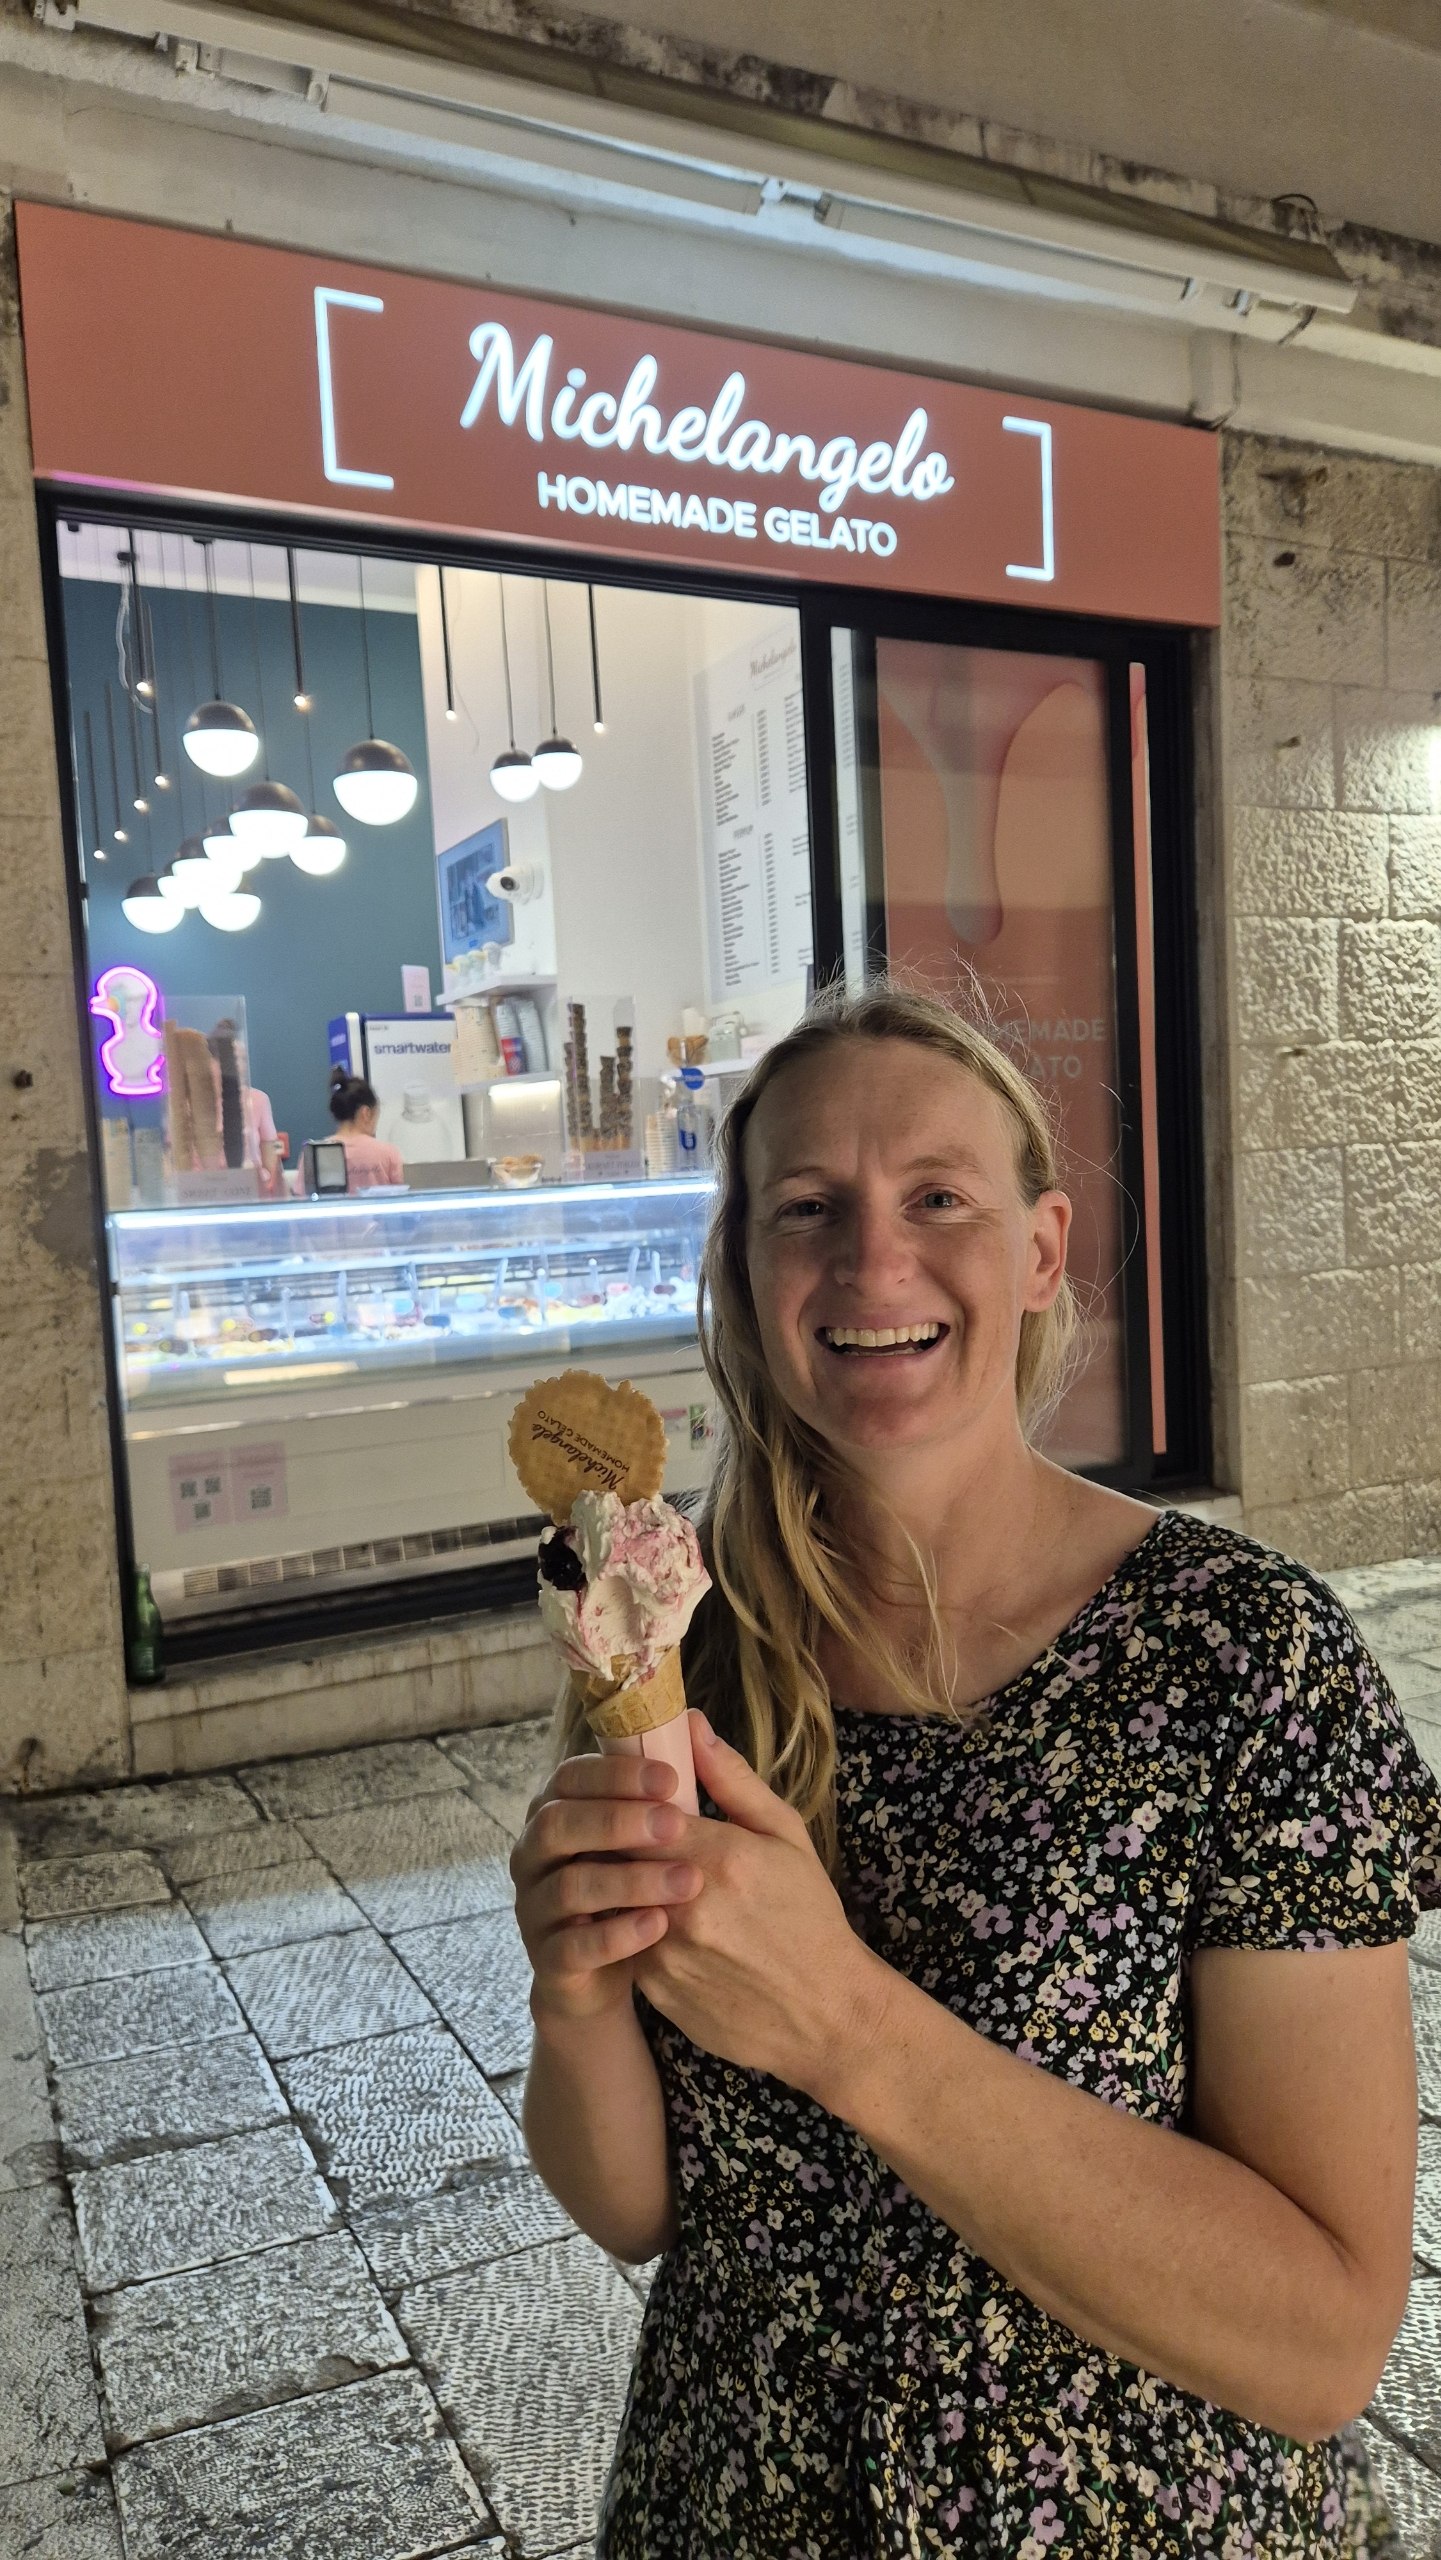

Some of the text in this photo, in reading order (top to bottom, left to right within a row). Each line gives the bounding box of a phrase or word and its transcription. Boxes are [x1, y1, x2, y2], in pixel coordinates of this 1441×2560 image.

[460, 322, 955, 513] Michelangelo
[538, 472, 898, 557] HOMEMADE GELATO
[532, 1422, 625, 1490] Michelangelo
[537, 1410, 631, 1473] HOMEMADE GELATO
